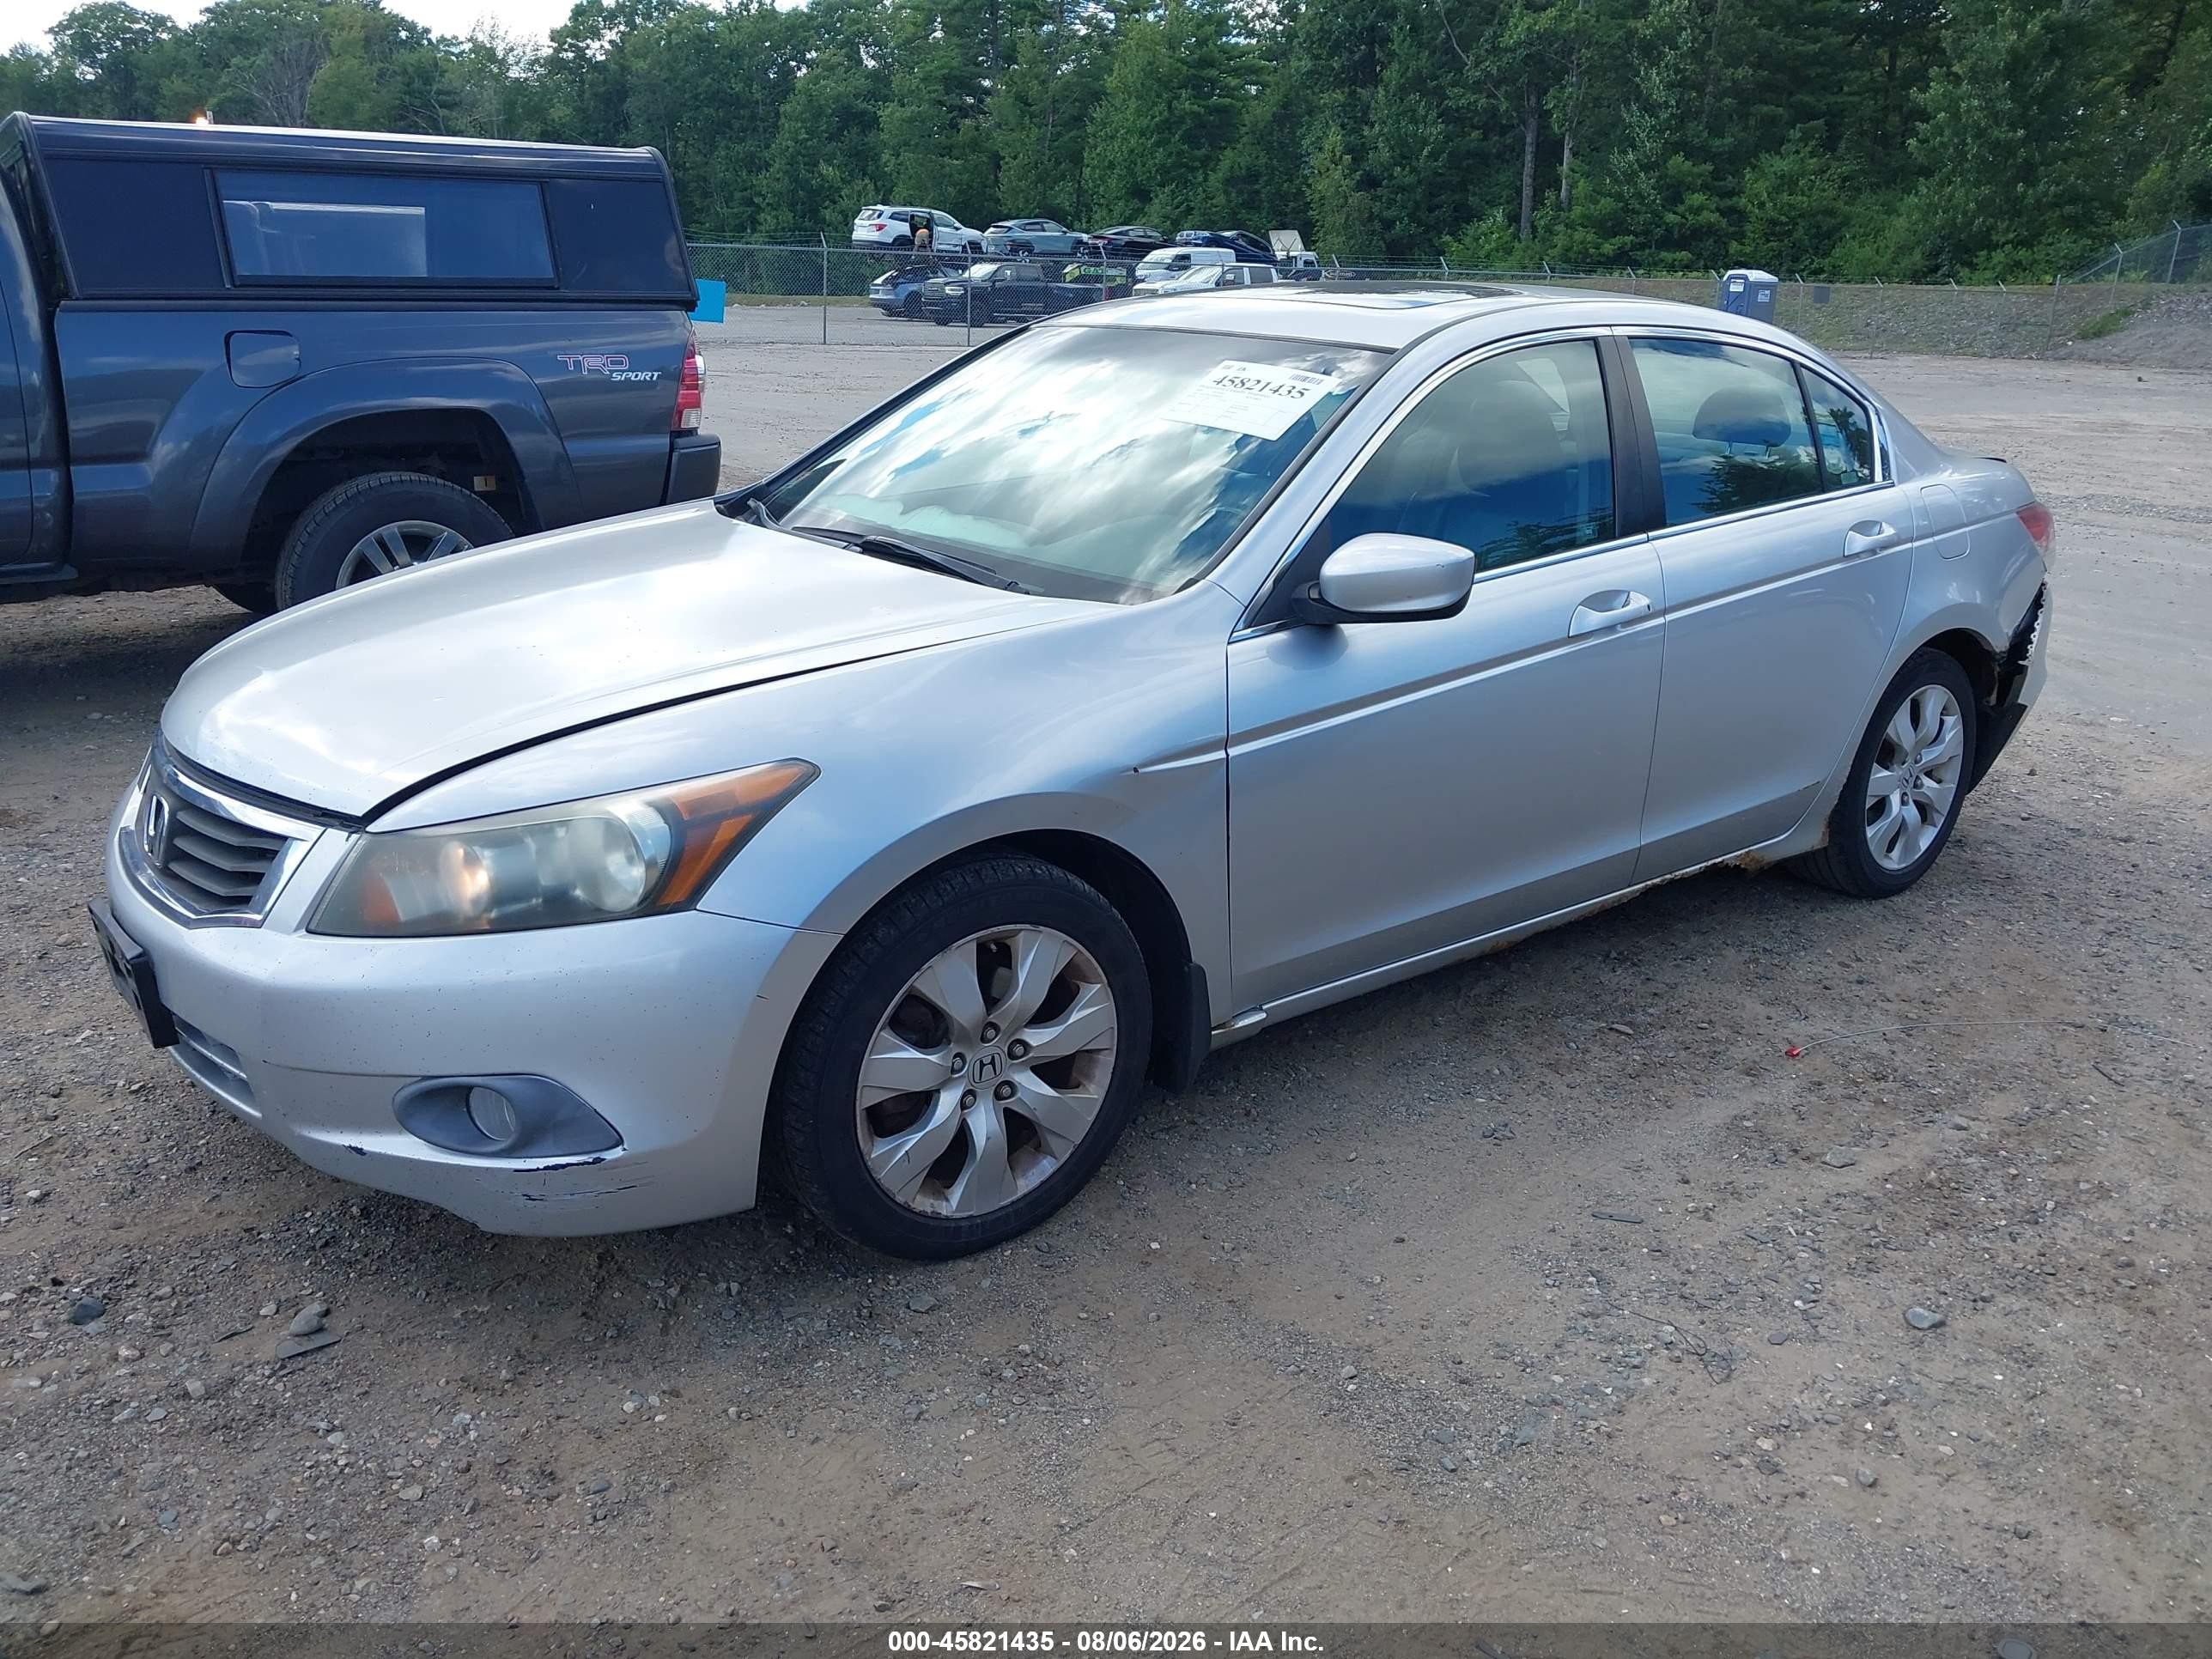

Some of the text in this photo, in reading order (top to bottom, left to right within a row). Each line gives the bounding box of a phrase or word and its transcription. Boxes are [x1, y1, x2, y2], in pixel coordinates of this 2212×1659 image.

[557, 355, 629, 374] TRD
[611, 371, 662, 381] SPORT
[1212, 374, 1311, 399] 45821435
